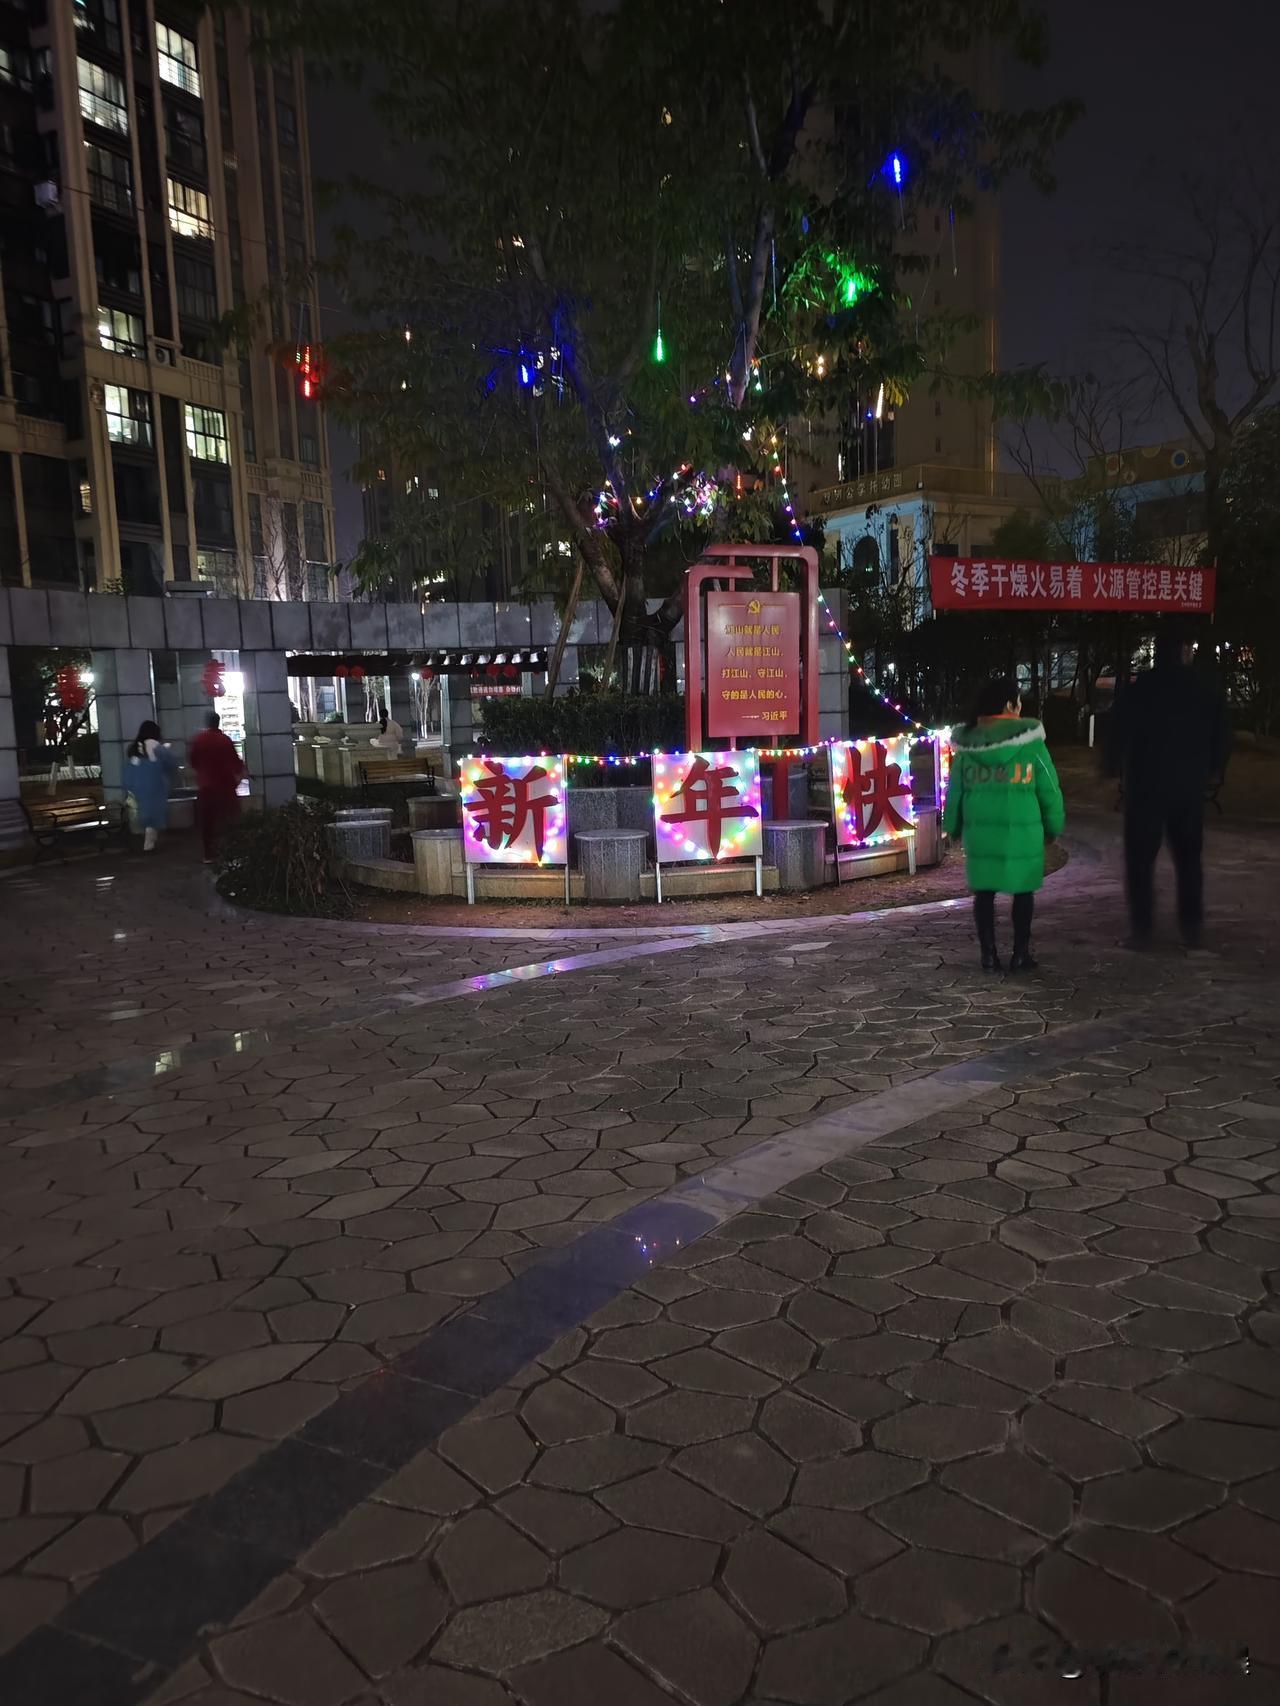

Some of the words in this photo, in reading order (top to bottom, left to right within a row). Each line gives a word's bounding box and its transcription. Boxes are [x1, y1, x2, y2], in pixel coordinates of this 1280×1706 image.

[950, 562, 1083, 599] 冬季干燥火易着
[1093, 567, 1203, 601] 火源管控是关键
[464, 757, 560, 865] 新
[660, 753, 760, 859] 年
[844, 745, 917, 843] 快
